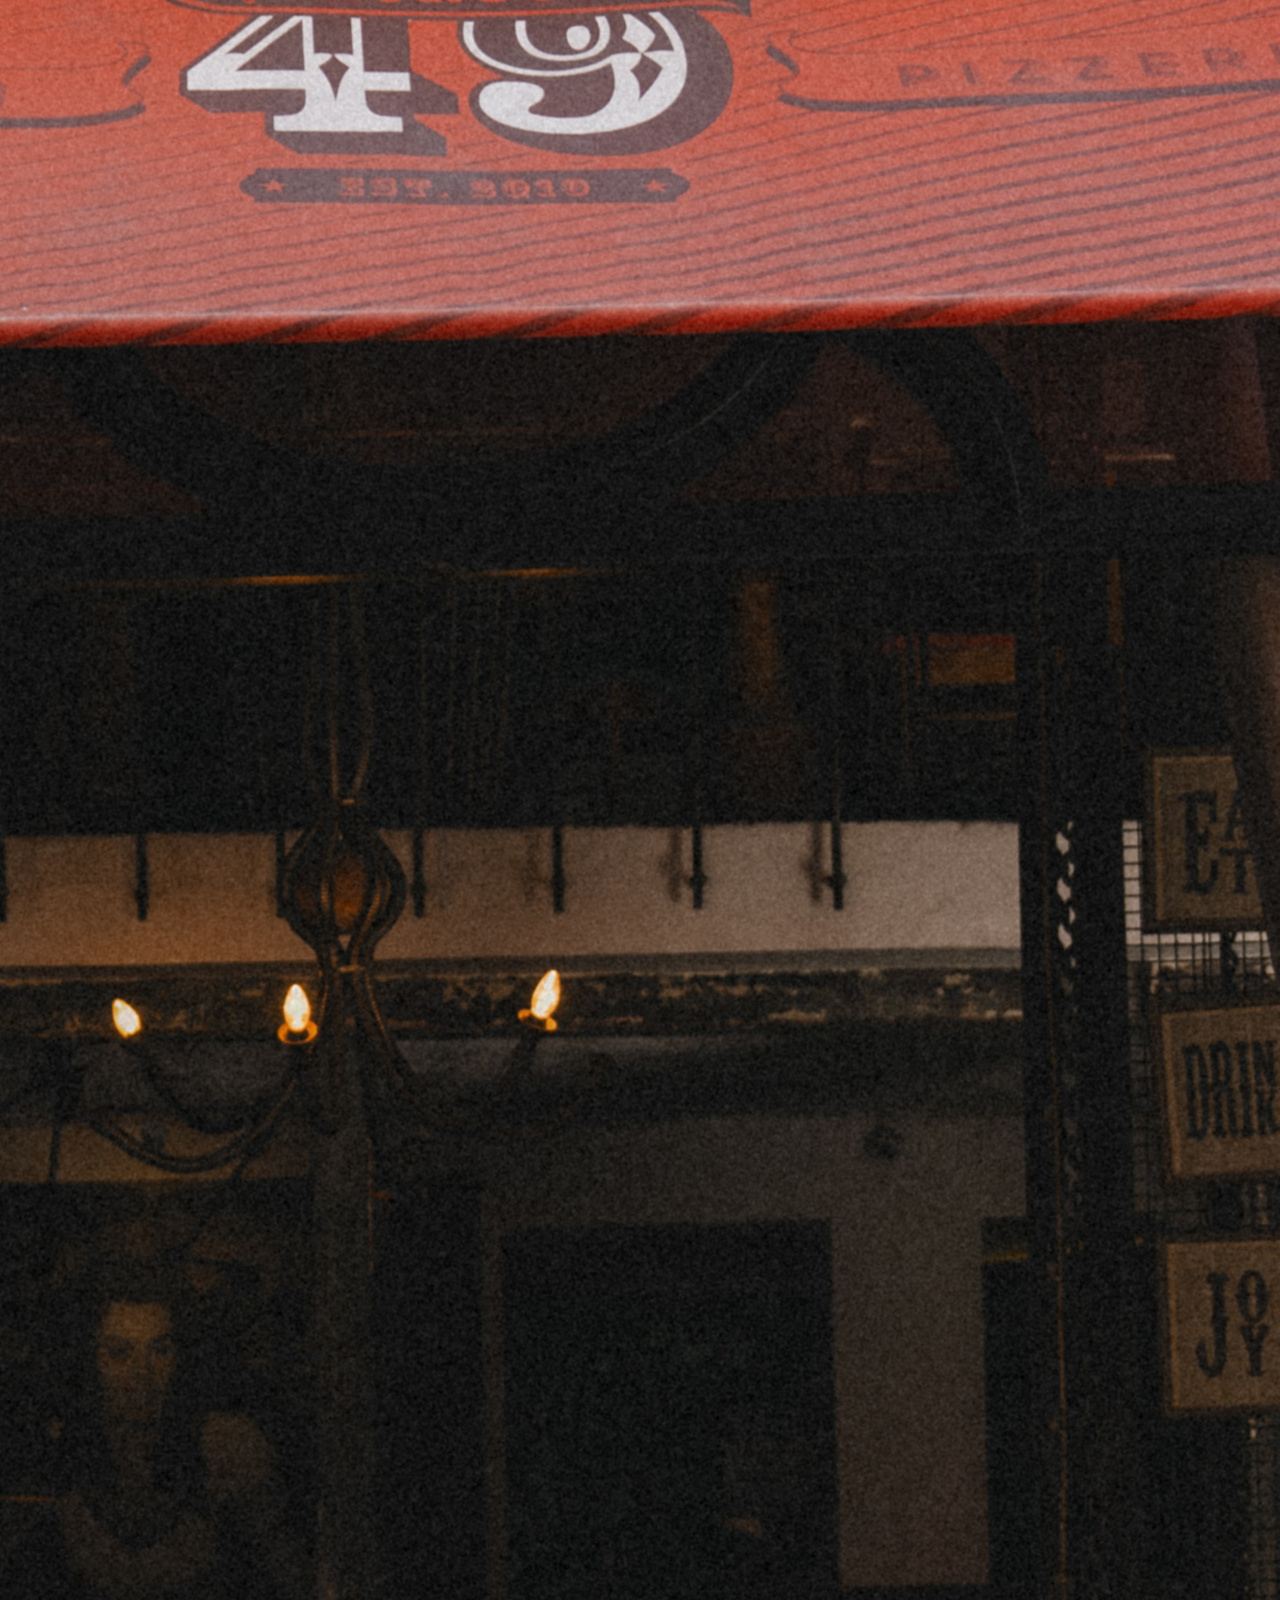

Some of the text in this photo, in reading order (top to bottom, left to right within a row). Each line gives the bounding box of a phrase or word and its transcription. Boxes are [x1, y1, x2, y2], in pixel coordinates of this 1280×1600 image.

[184, 10, 710, 140] 49
[338, 176, 591, 200] EST. 2010
[1196, 1269, 1270, 1378] JOY
